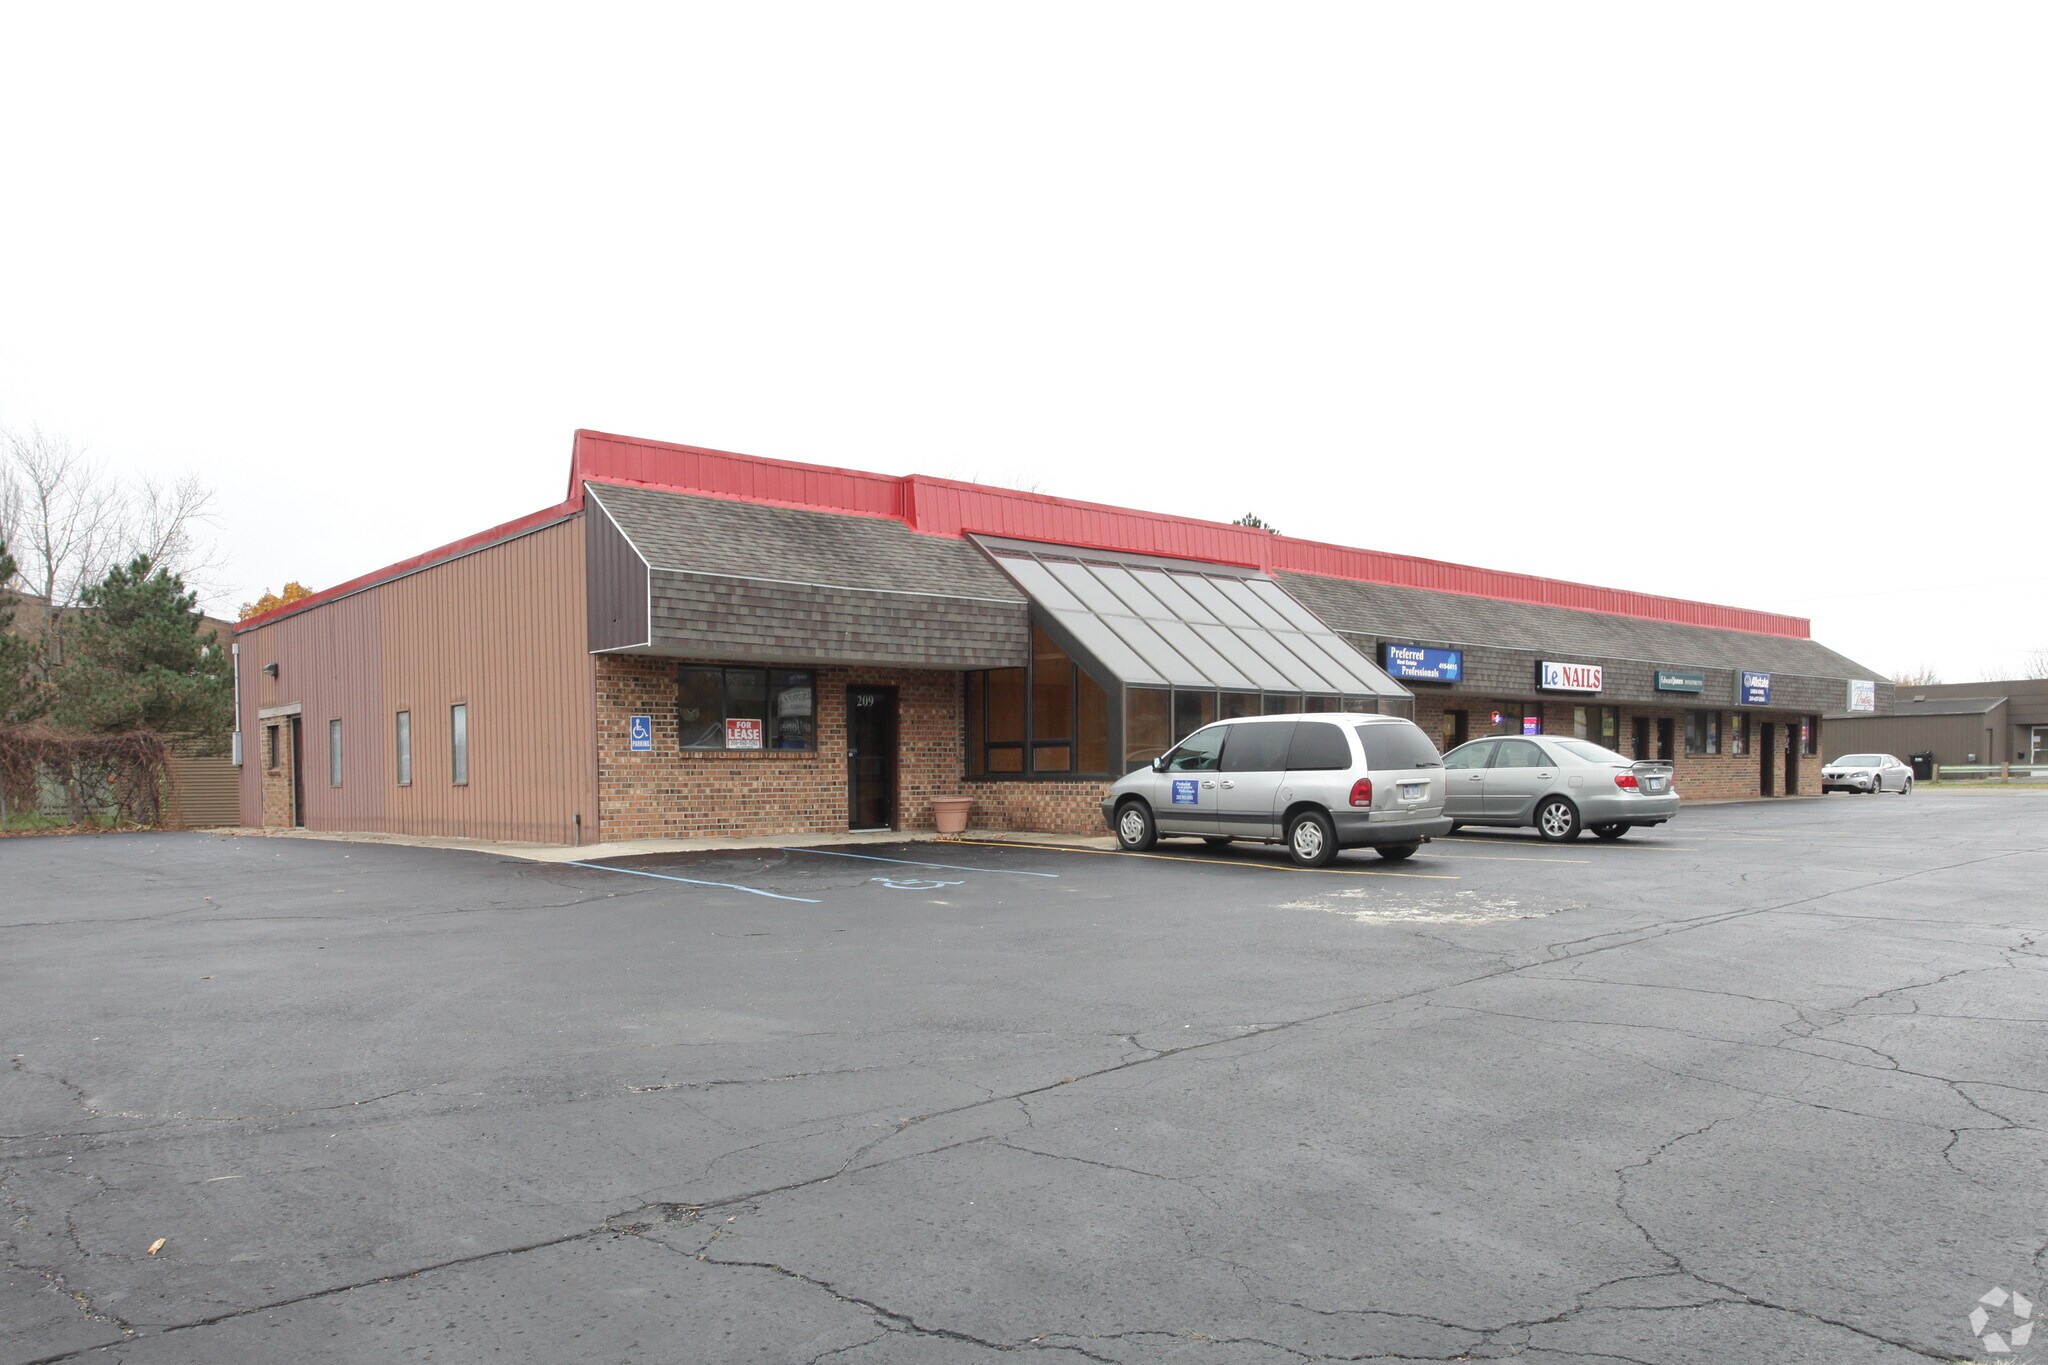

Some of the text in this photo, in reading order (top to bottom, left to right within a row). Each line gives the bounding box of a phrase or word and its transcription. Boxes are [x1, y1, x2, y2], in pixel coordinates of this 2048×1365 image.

[1390, 646, 1424, 660] Preferred
[1401, 665, 1439, 677] Professionals
[1544, 665, 1600, 689] Le NAILS
[1751, 676, 1769, 688] Allstate
[856, 695, 874, 707] 209
[736, 721, 752, 729] FOR
[728, 729, 760, 740] LEASE
